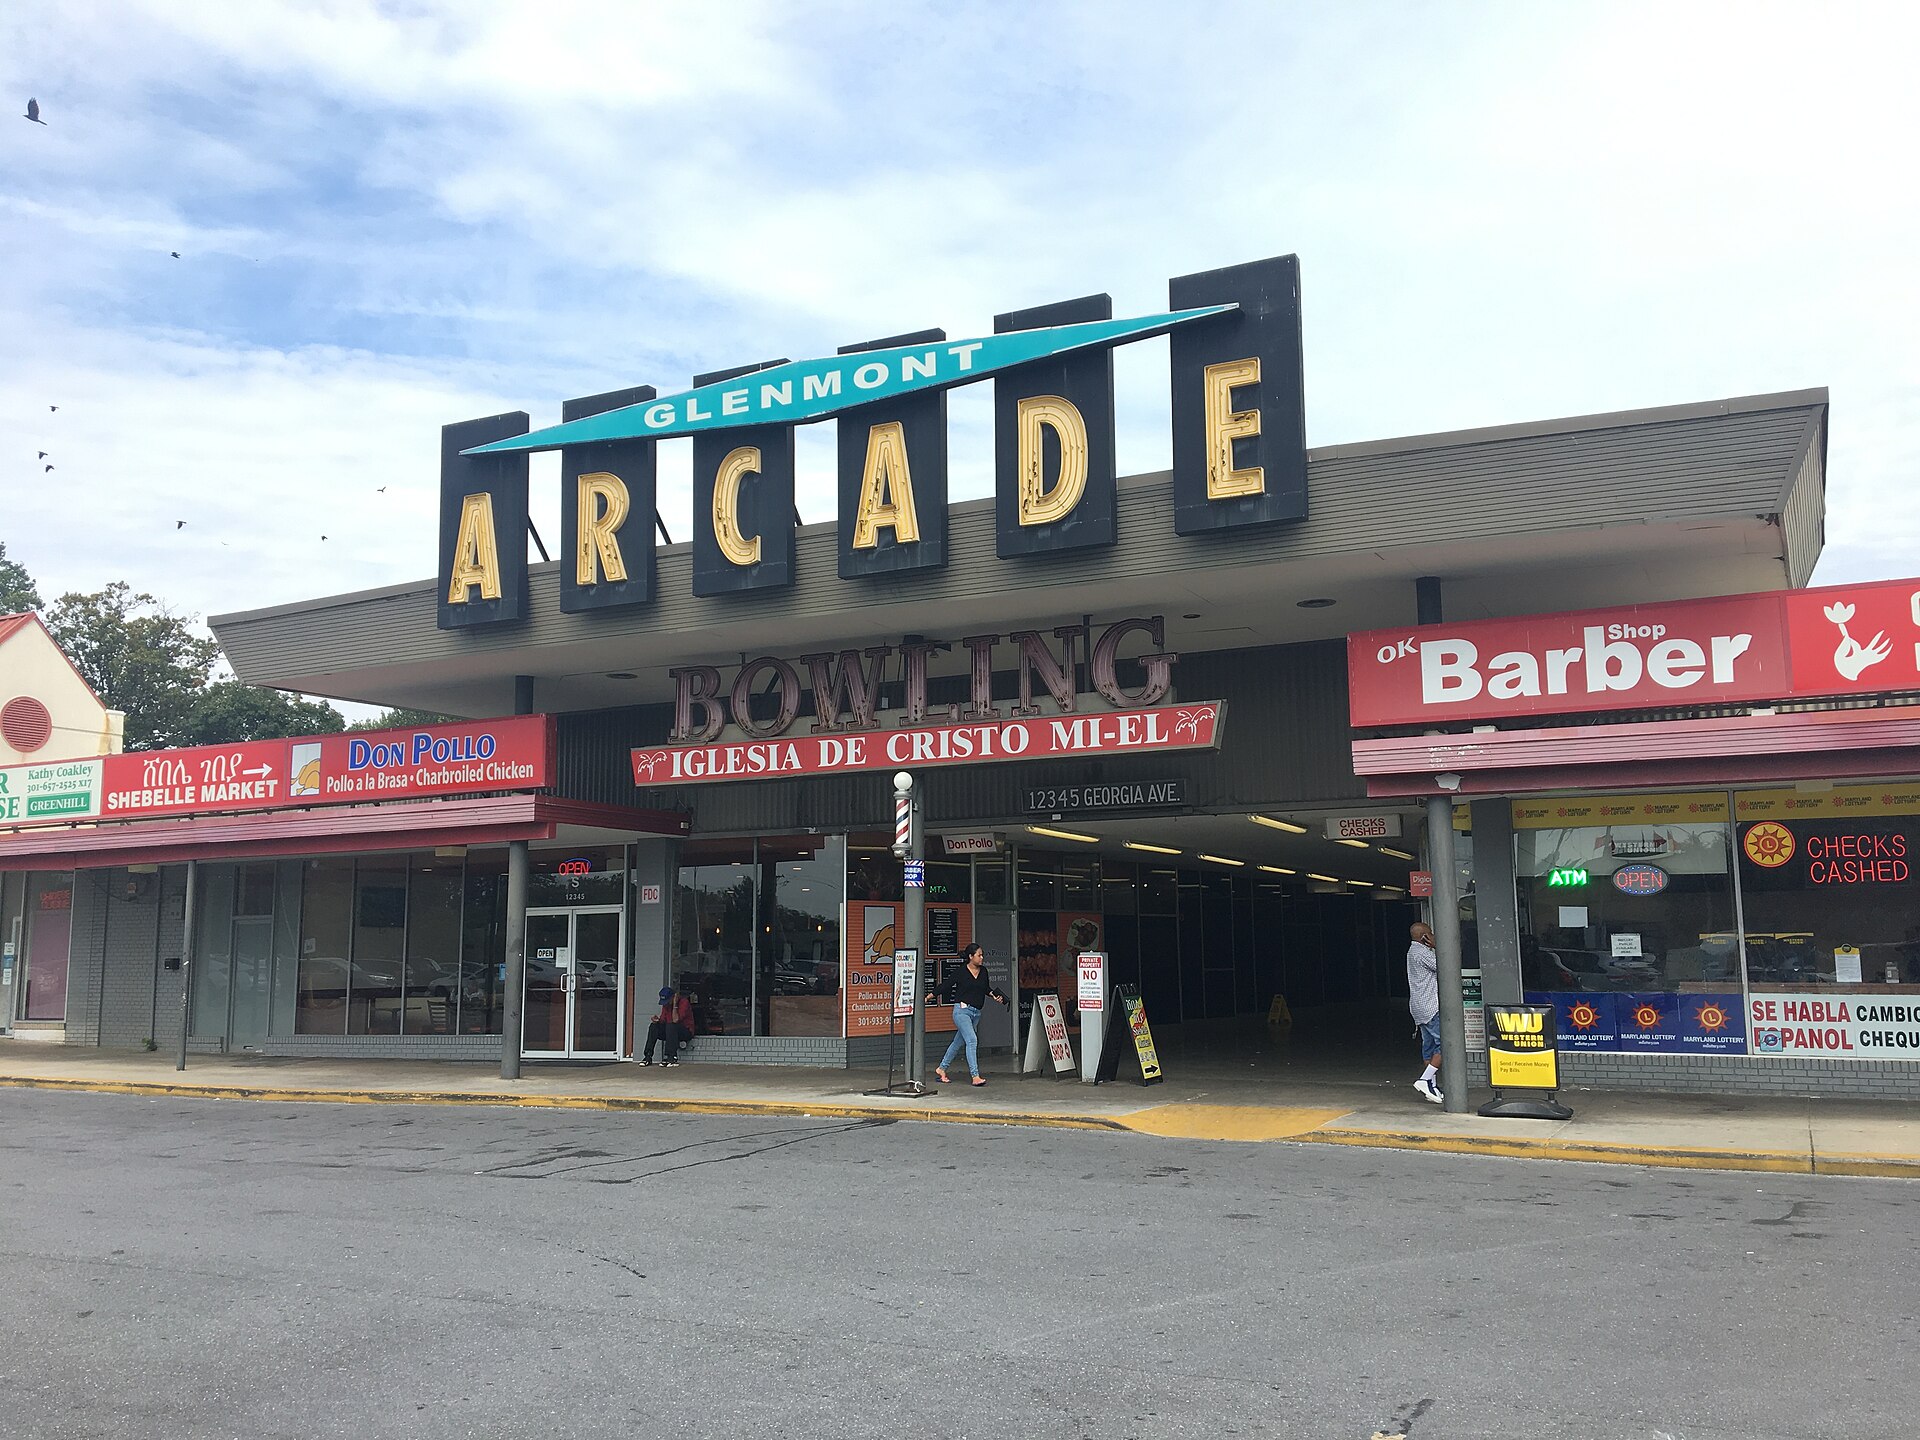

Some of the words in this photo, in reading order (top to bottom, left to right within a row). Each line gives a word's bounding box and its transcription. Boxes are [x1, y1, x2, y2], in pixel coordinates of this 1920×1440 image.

[643, 341, 984, 429] GLENMONT
[447, 356, 1266, 604] ARCADE
[1607, 623, 1666, 642] Shop
[1376, 636, 1419, 664] OK
[1422, 625, 1753, 704] Barber
[668, 615, 1179, 745] BOWLING
[348, 738, 405, 770] DON
[412, 733, 497, 766] POLLO
[670, 741, 802, 778] IGLESIA
[817, 736, 868, 767] DE
[886, 723, 1030, 763] CRISTO
[1049, 712, 1170, 752] MI-EL
[28, 768, 54, 781] Kathy
[56, 764, 93, 777] Coakley
[326, 775, 354, 793] Pollo
[356, 778, 363, 790] a
[365, 773, 374, 790] la
[377, 772, 408, 788] Brasa
[416, 765, 485, 787] Charbroiled
[486, 761, 534, 780] Chicken
[27, 781, 77, 793] 301-657-2525
[107, 786, 196, 810] SHEBELLE
[200, 779, 279, 803] MARKET
[30, 797, 87, 811] GREENHILL
[1029, 788, 1080, 810] 12345
[1084, 785, 1144, 807] GEORGIA
[1147, 783, 1180, 803] AVE.
[1340, 818, 1386, 829] CHECKS
[1341, 827, 1386, 837] CASHED
[947, 840, 967, 849] Don
[969, 838, 993, 848] Pollo
[1807, 834, 1906, 858] CHECKS
[559, 862, 590, 876] OPEN
[1549, 869, 1588, 886] ATM
[1810, 860, 1909, 884] CASHED
[571, 877, 580, 888] S
[1616, 872, 1663, 888] OPEN
[643, 888, 659, 901] FDC
[538, 949, 553, 957] OPEN
[851, 972, 873, 985] DON
[1083, 970, 1097, 980] NO
[858, 992, 872, 1000] Pollo
[852, 1003, 884, 1012] Charbroiled
[1046, 1007, 1055, 1016] OK
[1752, 1000, 1778, 1022] SE
[1784, 1001, 1852, 1022] HABLA
[1495, 1012, 1543, 1033] WU
[1046, 1023, 1067, 1041] BARBER
[1753, 1027, 1854, 1050] EPANOL
[1051, 1043, 1065, 1062] SHOP
